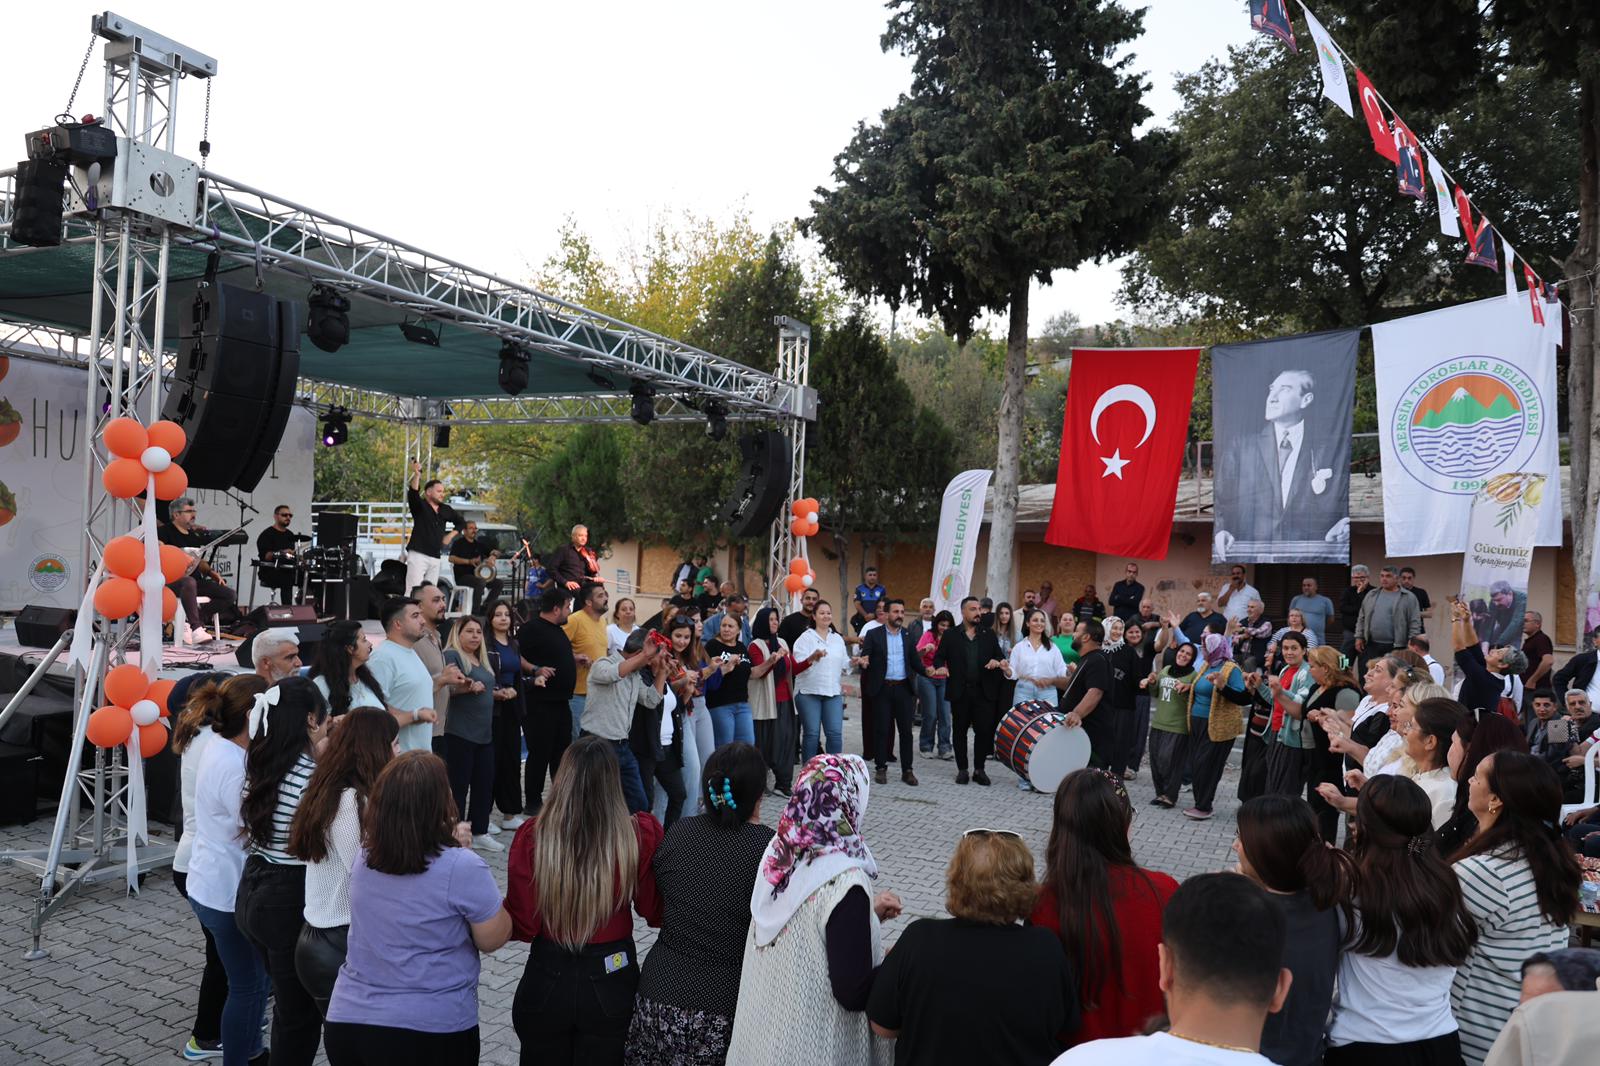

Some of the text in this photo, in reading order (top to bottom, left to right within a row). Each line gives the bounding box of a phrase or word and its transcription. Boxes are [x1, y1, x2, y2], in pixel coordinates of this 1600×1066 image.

[33, 397, 78, 461] HU
[1396, 360, 1539, 453] MERSİN TOROSLAR BELEDİYESİ
[952, 487, 972, 566] BELEDİYESİ
[1473, 541, 1530, 558] Gücümüz
